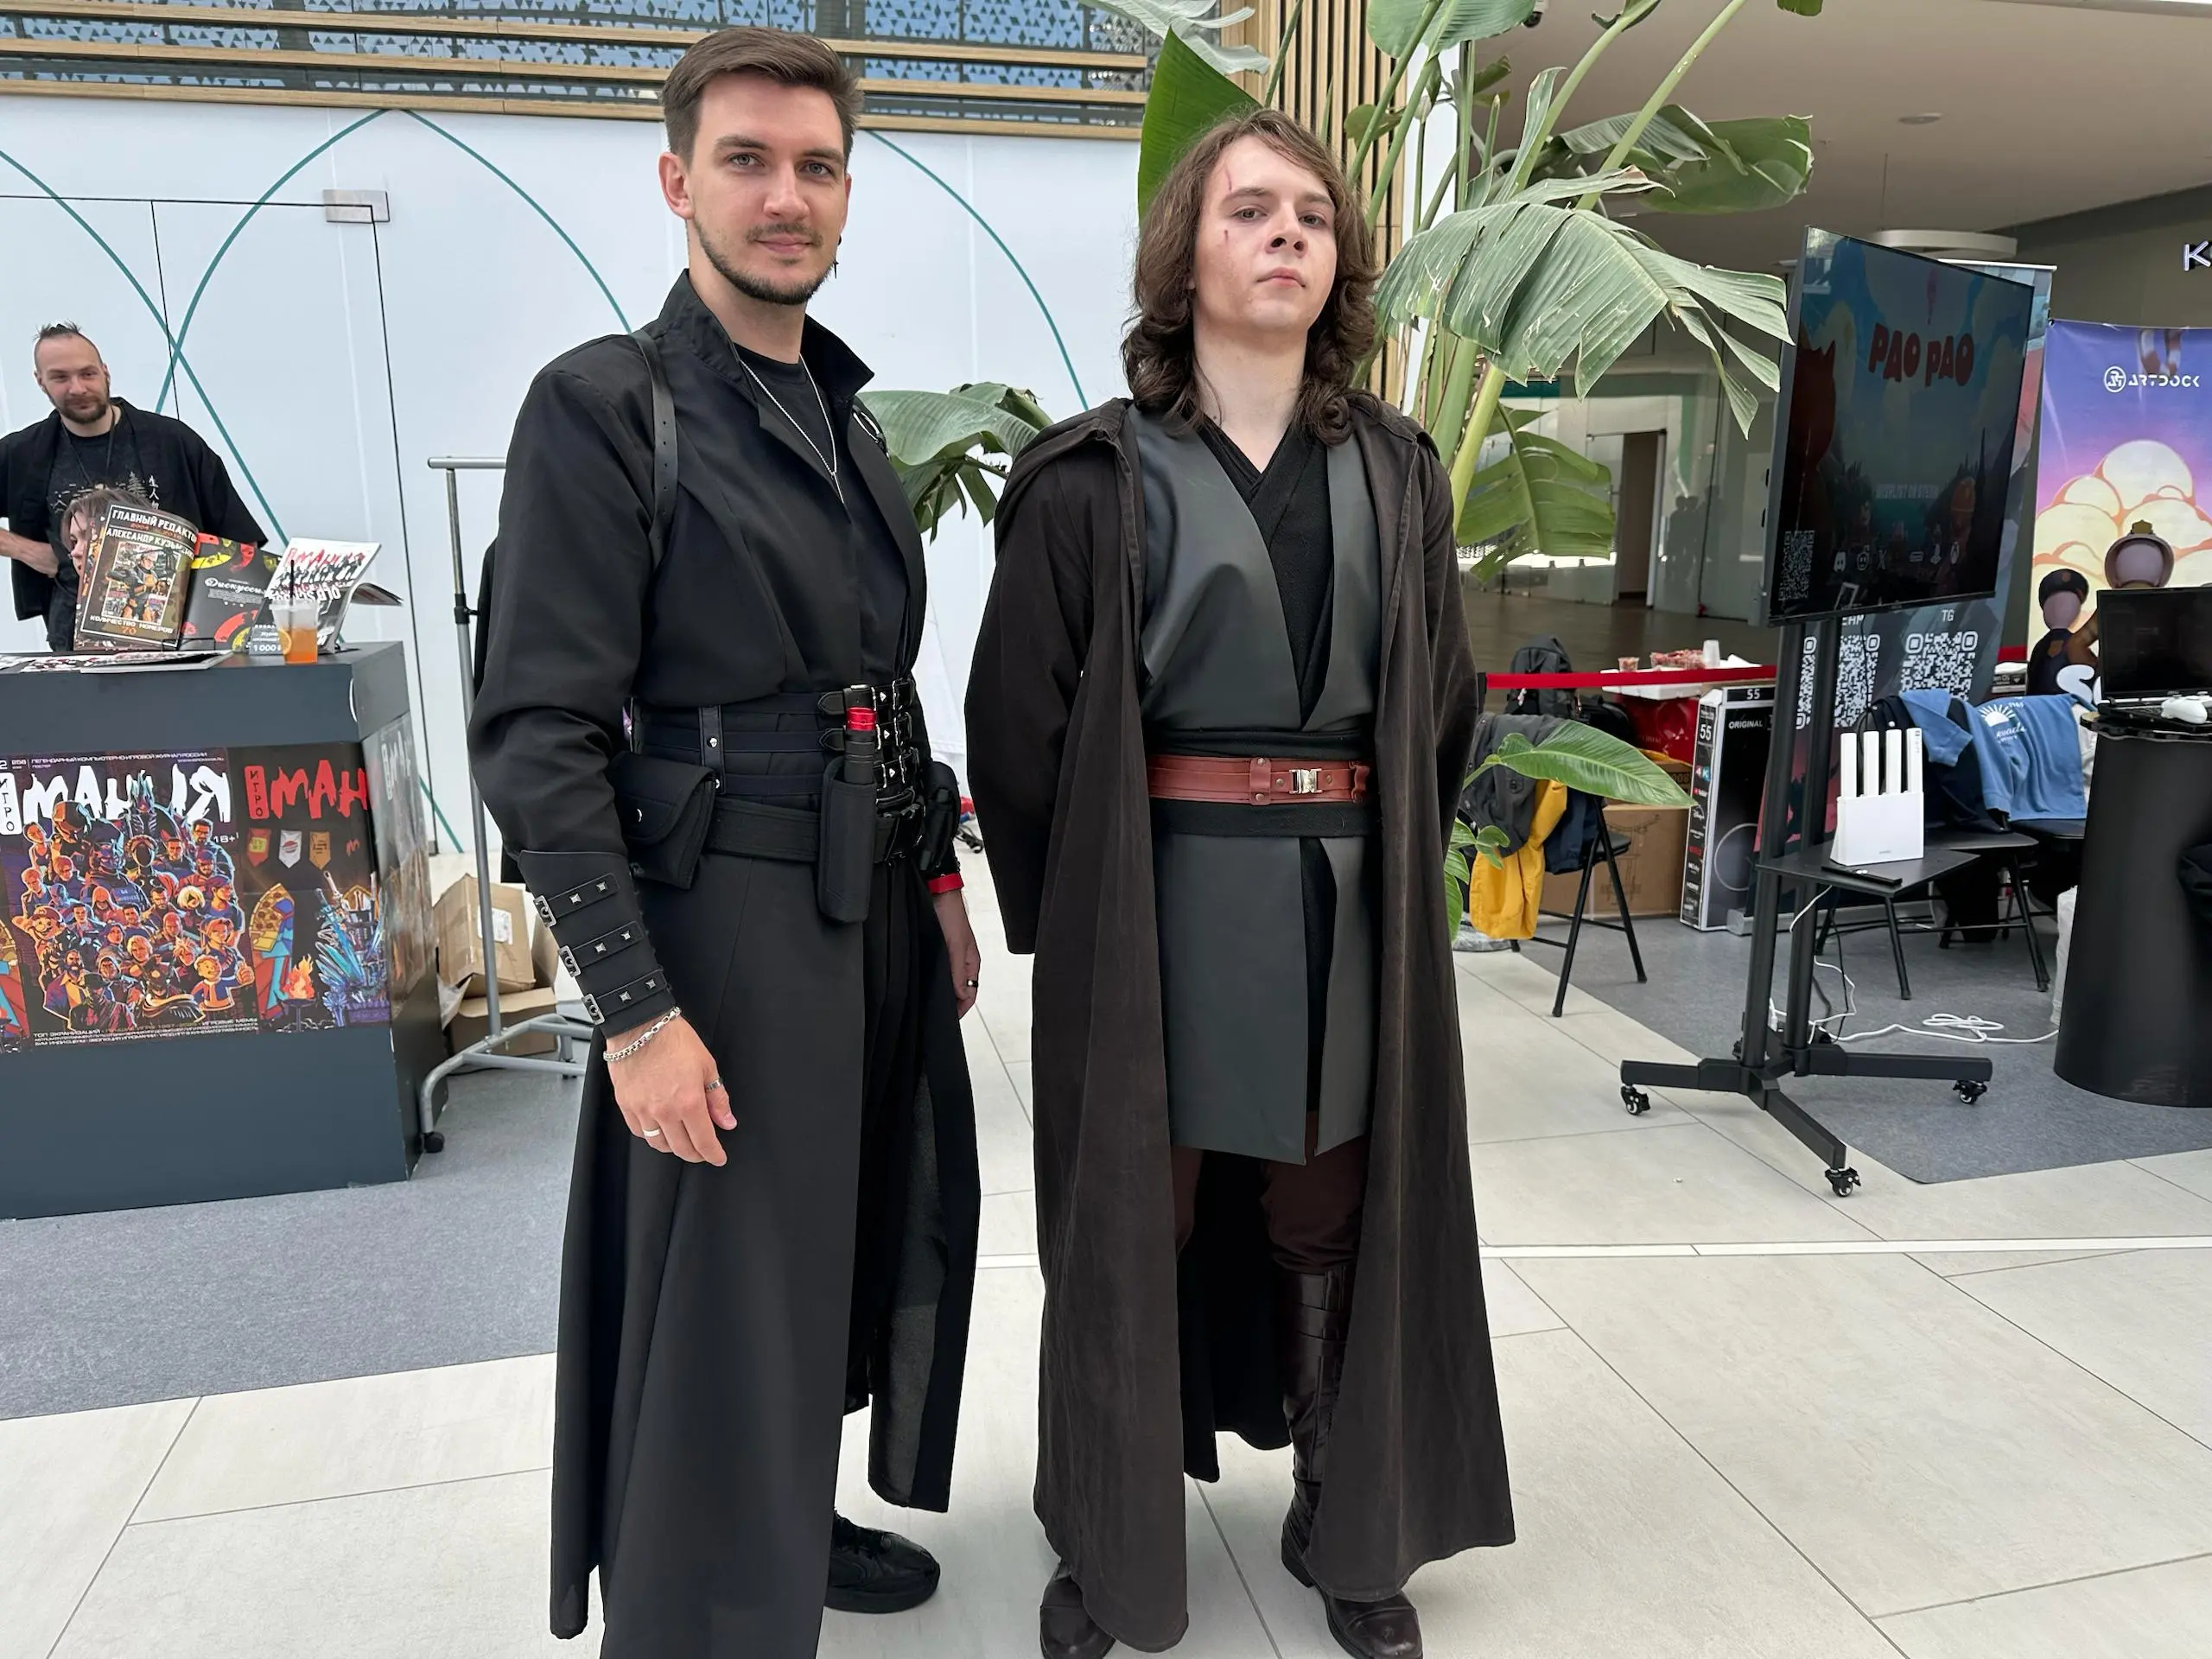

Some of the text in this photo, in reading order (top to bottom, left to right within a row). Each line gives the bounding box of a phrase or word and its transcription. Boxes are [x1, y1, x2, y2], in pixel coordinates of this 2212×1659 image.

[1868, 322, 1974, 389] PAO PAO
[2128, 374, 2200, 387] ARTDOCK
[112, 510, 197, 543] ГЛАВНЫЙ РЕДАКТО
[106, 529, 154, 542] АЛЕКСАНДР
[1942, 609, 1955, 622] TG
[1746, 689, 1760, 700] 55
[1728, 721, 1763, 730] ORIGINAL
[1700, 724, 1712, 741] 55
[250, 770, 264, 817] ИГРО
